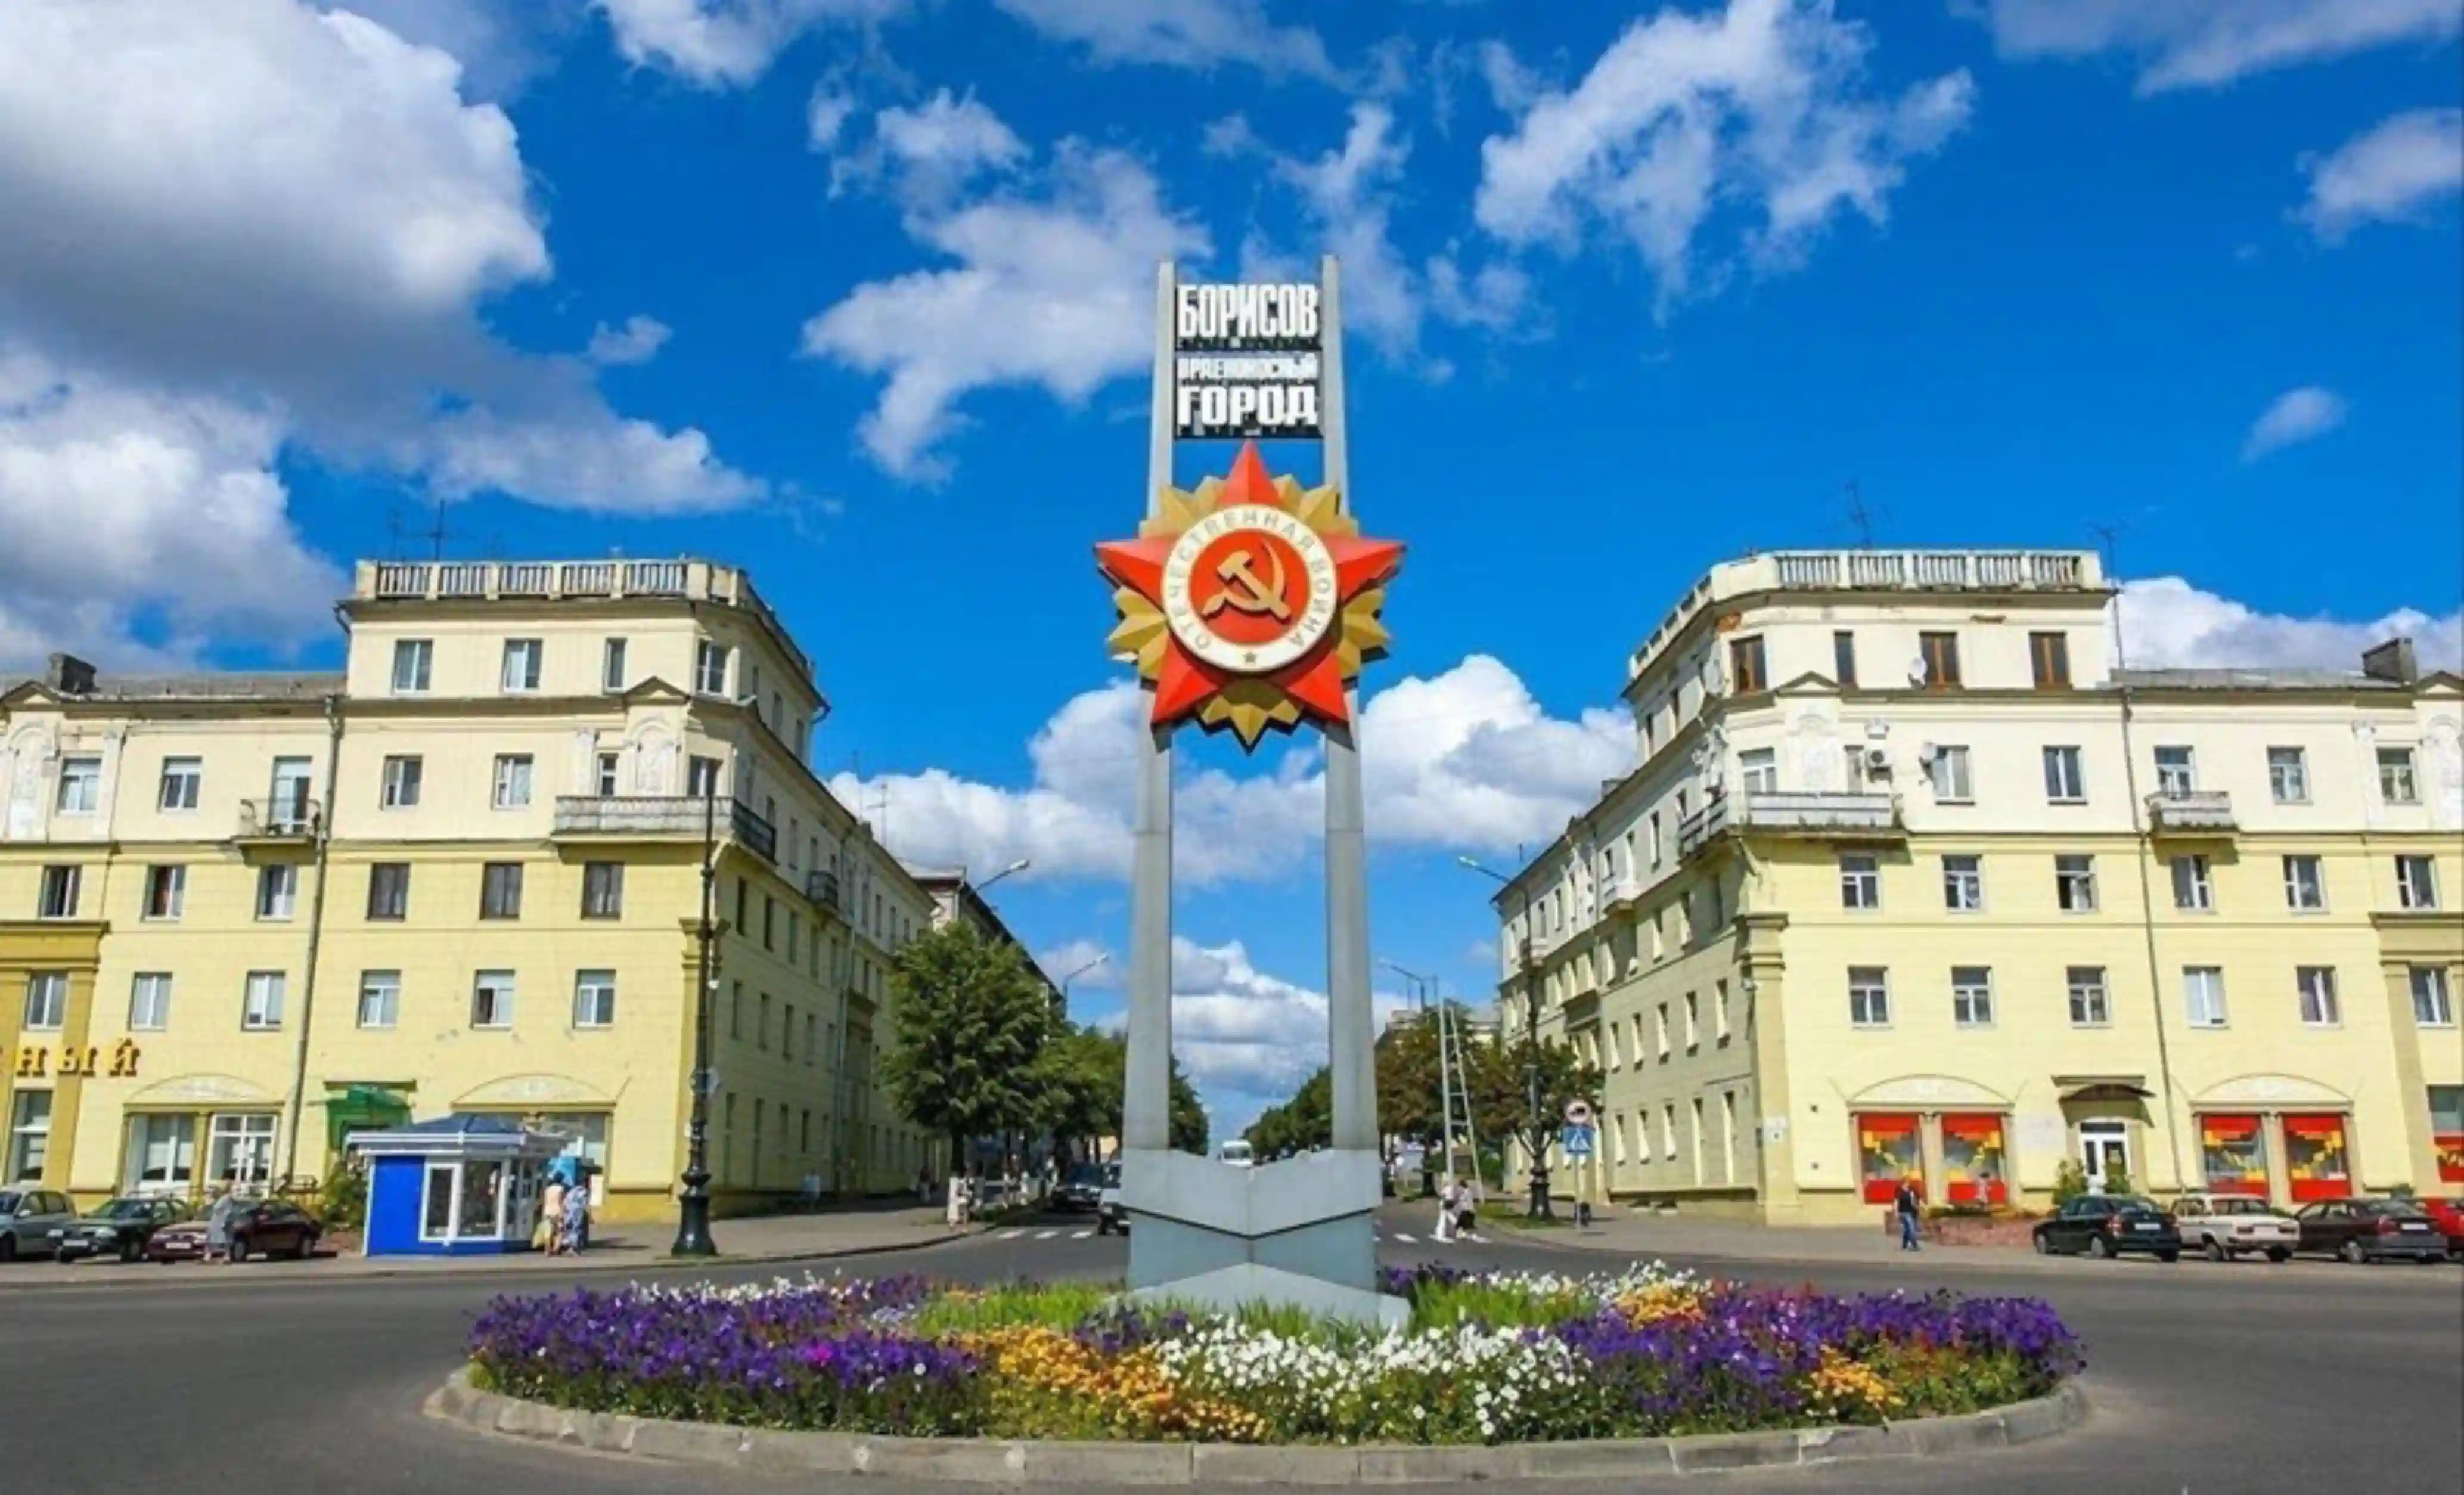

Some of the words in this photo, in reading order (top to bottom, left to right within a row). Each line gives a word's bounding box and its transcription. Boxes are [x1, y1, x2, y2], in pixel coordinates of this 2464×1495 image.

[1177, 283, 1318, 338] БОРИСОВ
[1177, 386, 1318, 426] ГОРОД
[1167, 511, 1315, 650] ОТЕЧЕСТВЕННАЯ
[1289, 559, 1332, 647] ВОЙНА
